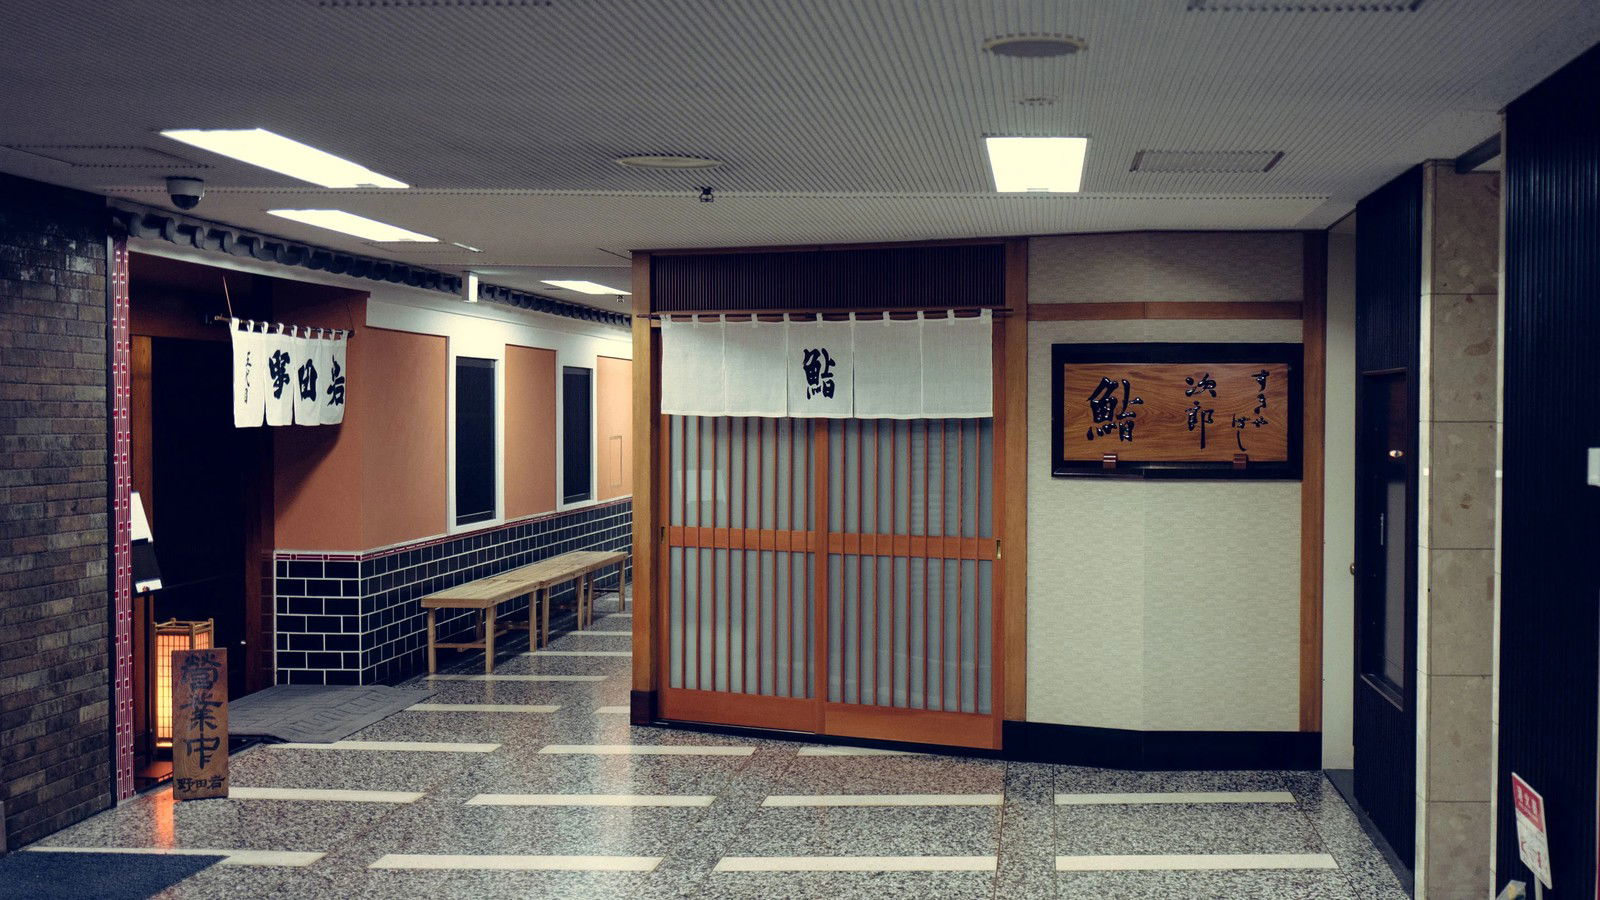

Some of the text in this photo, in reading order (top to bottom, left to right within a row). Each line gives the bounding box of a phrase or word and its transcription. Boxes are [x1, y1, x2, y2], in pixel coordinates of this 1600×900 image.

[802, 347, 836, 400] 鮨
[1086, 376, 1144, 442] 鮨
[1185, 372, 1217, 450] 次郎
